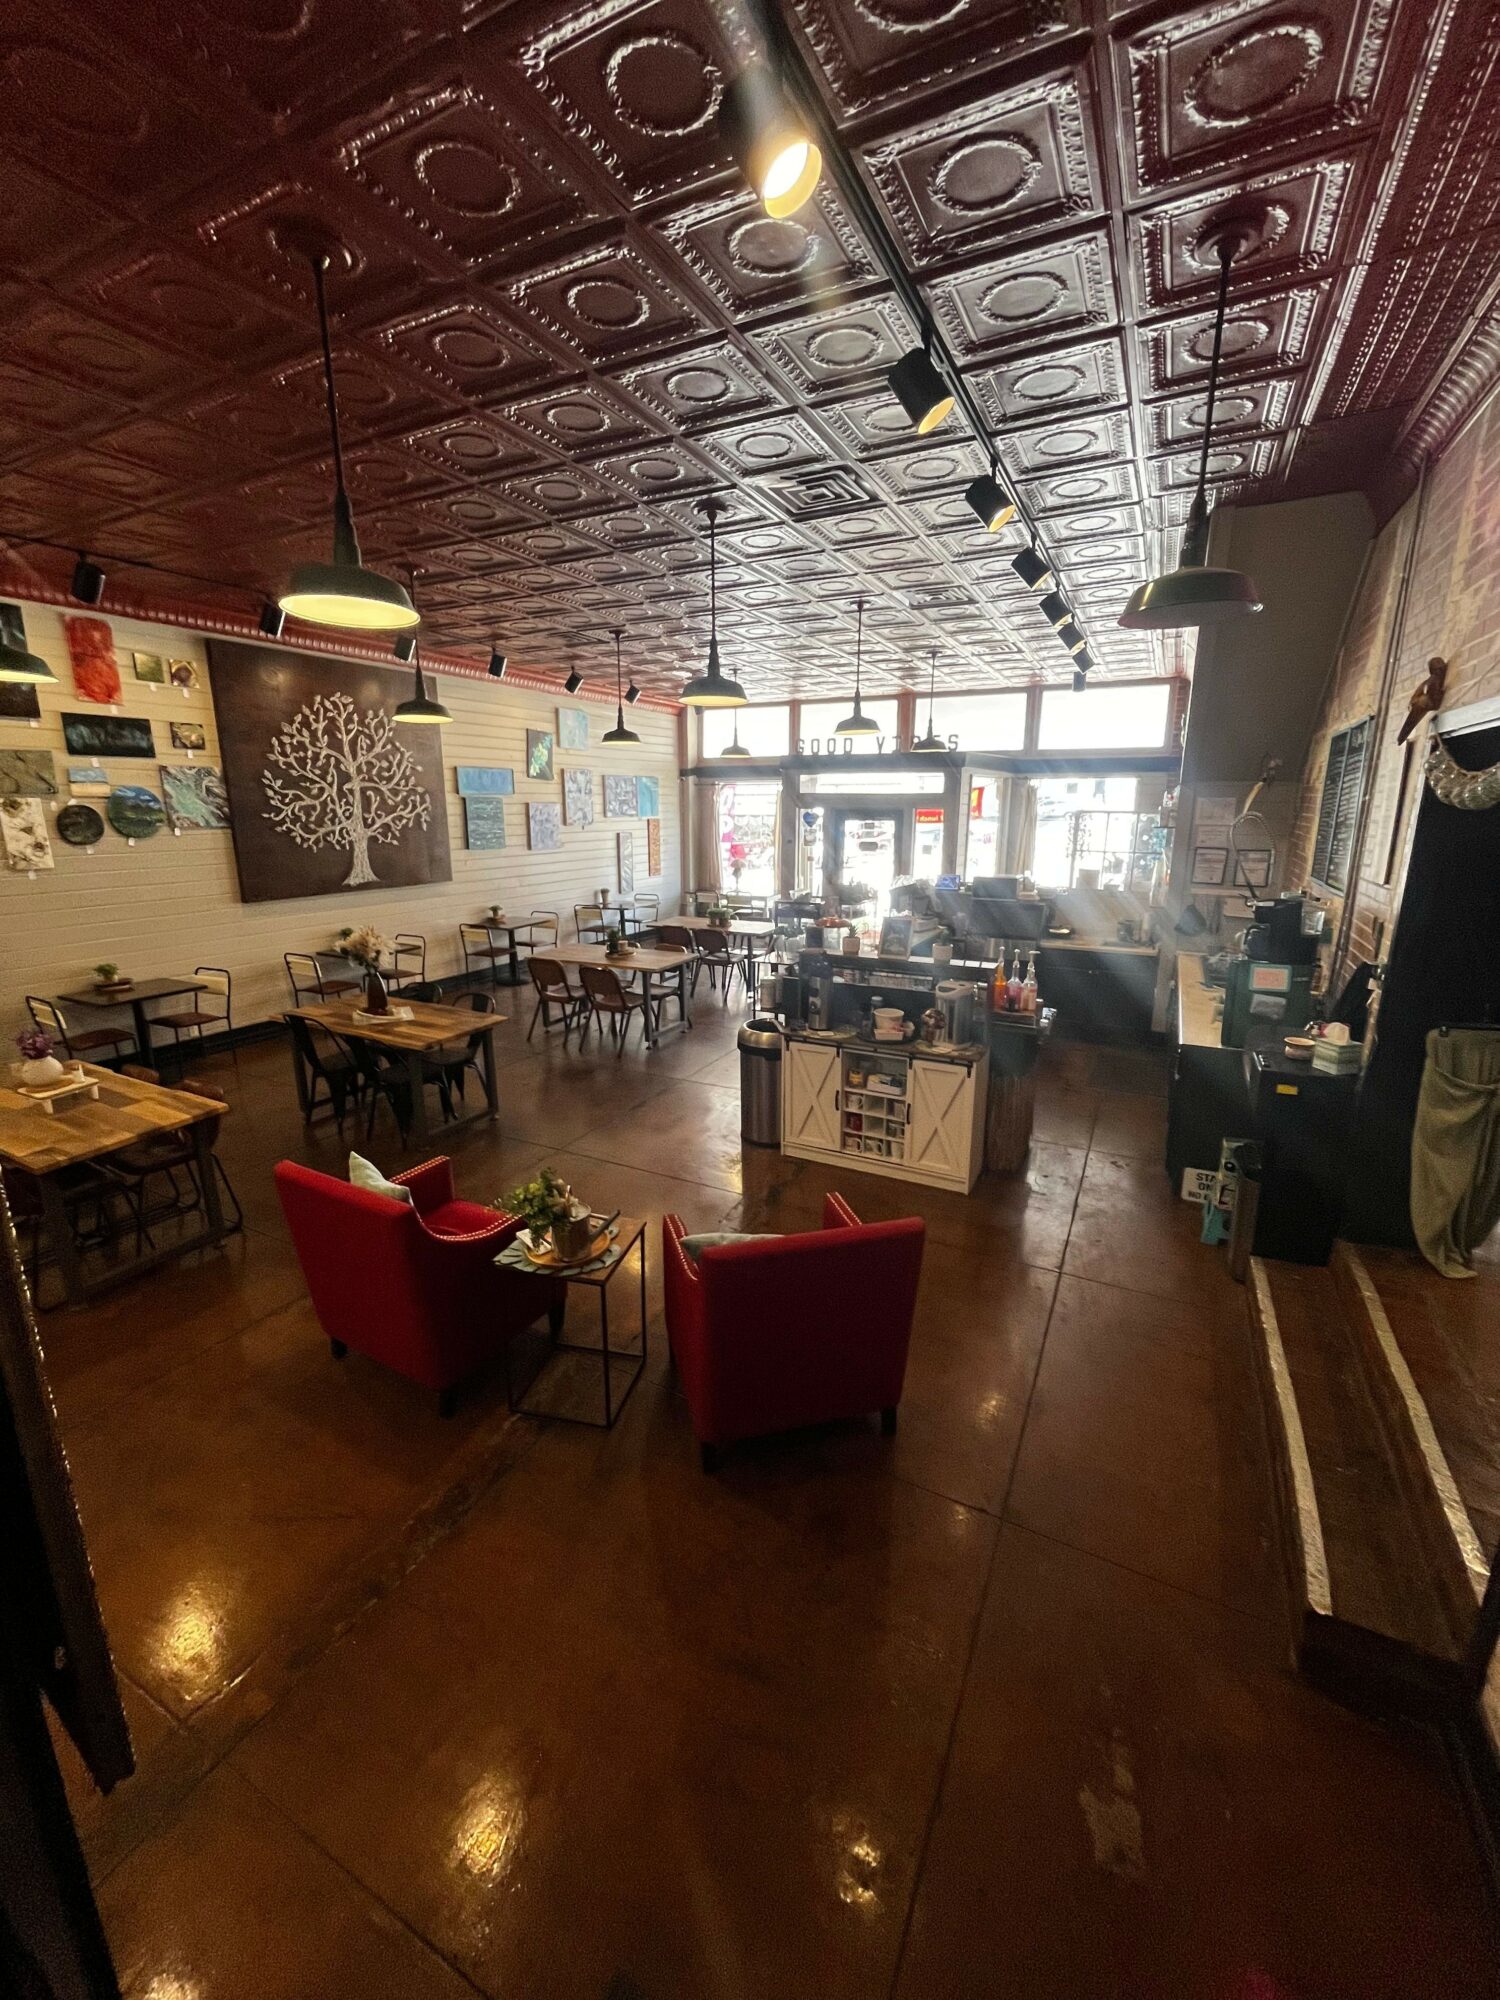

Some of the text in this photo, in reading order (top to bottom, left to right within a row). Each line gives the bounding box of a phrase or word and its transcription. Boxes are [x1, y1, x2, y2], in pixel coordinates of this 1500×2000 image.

[796, 735, 959, 755] GOOD VIS
[1195, 1172, 1217, 1182] STA
